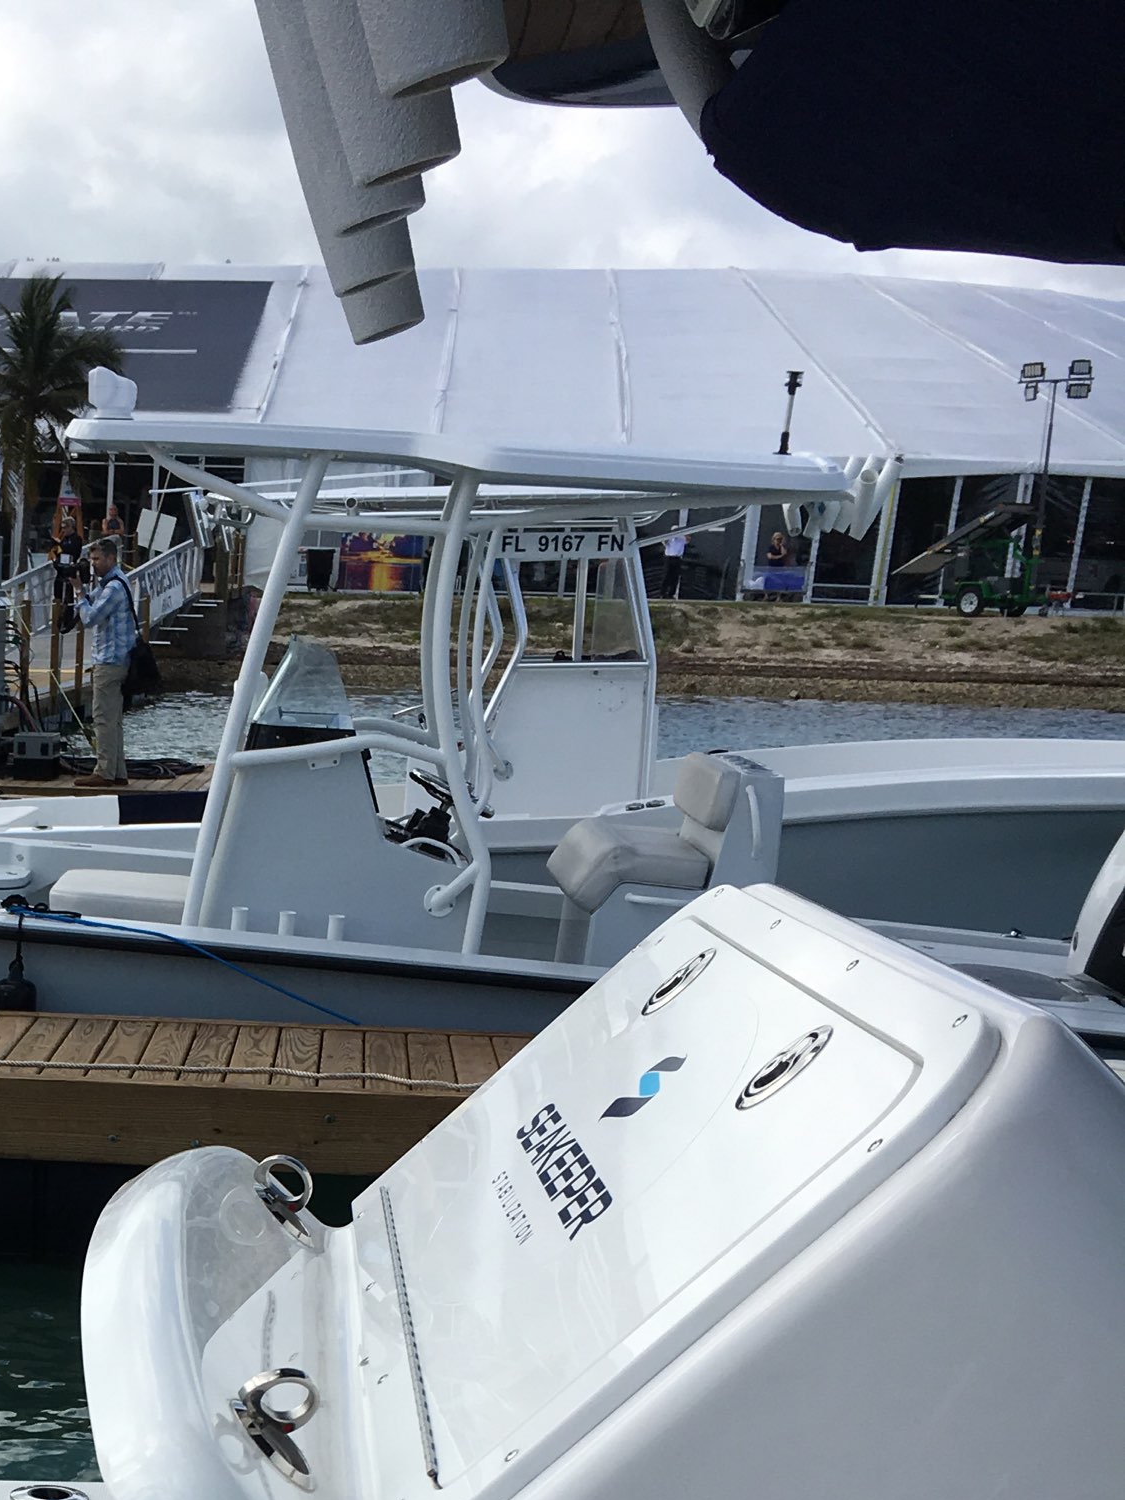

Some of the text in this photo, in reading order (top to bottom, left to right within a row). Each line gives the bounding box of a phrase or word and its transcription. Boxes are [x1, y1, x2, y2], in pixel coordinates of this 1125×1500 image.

[501, 534, 625, 552] FL 9167 FN
[491, 1170, 534, 1246] STABILIZATION
[516, 1103, 613, 1241] SEAKEEPER
